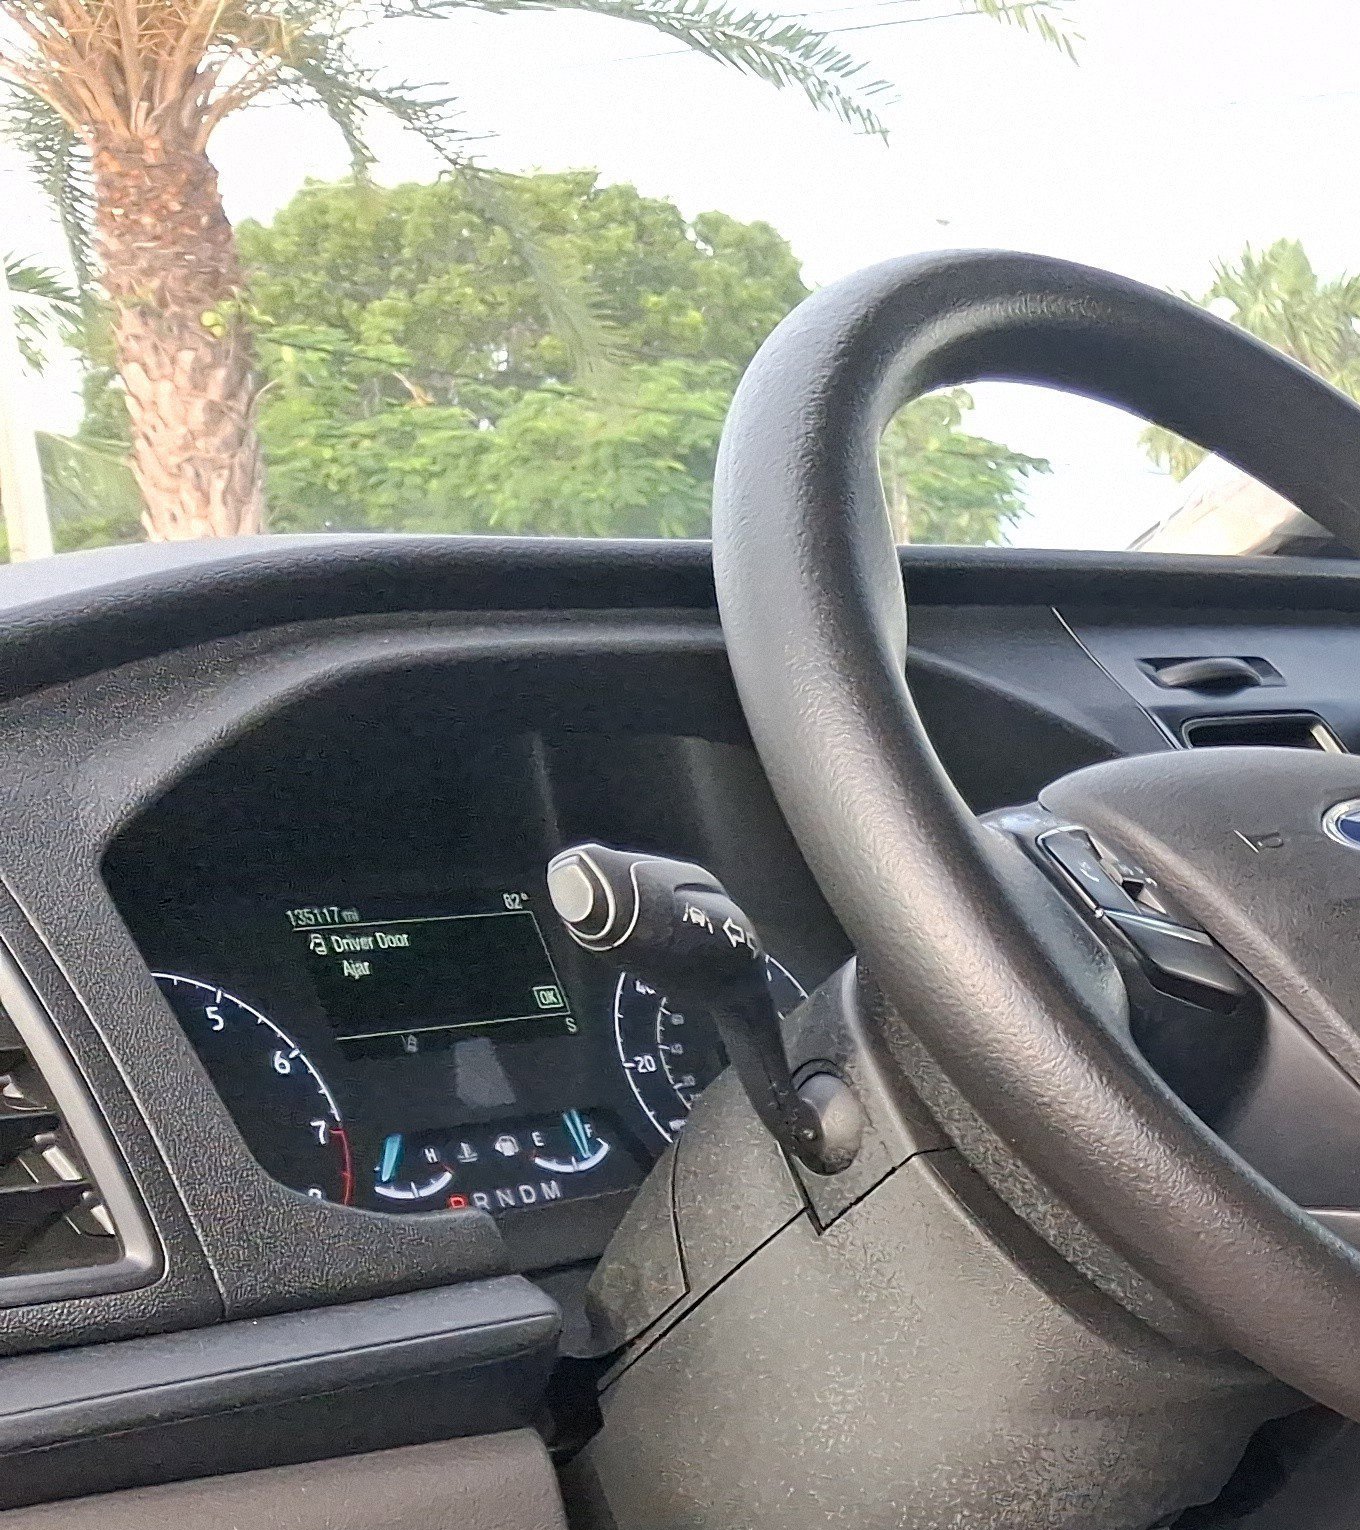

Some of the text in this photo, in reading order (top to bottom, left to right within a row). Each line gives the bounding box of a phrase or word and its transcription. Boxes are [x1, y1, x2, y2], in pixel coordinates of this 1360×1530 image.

[284, 906, 341, 927] 135117
[330, 931, 410, 954] Driver Door
[341, 958, 372, 980] Ajar
[539, 990, 557, 1005] OK
[204, 1005, 225, 1032] 5
[273, 1050, 291, 1075] 6
[634, 1054, 657, 1074] 20
[309, 1119, 327, 1146] 7
[531, 1131, 545, 1148] E
[423, 1147, 439, 1164] H
[472, 1191, 490, 1210] R
[495, 1188, 516, 1208] N
[518, 1184, 537, 1204] D
[540, 1179, 562, 1201] M
